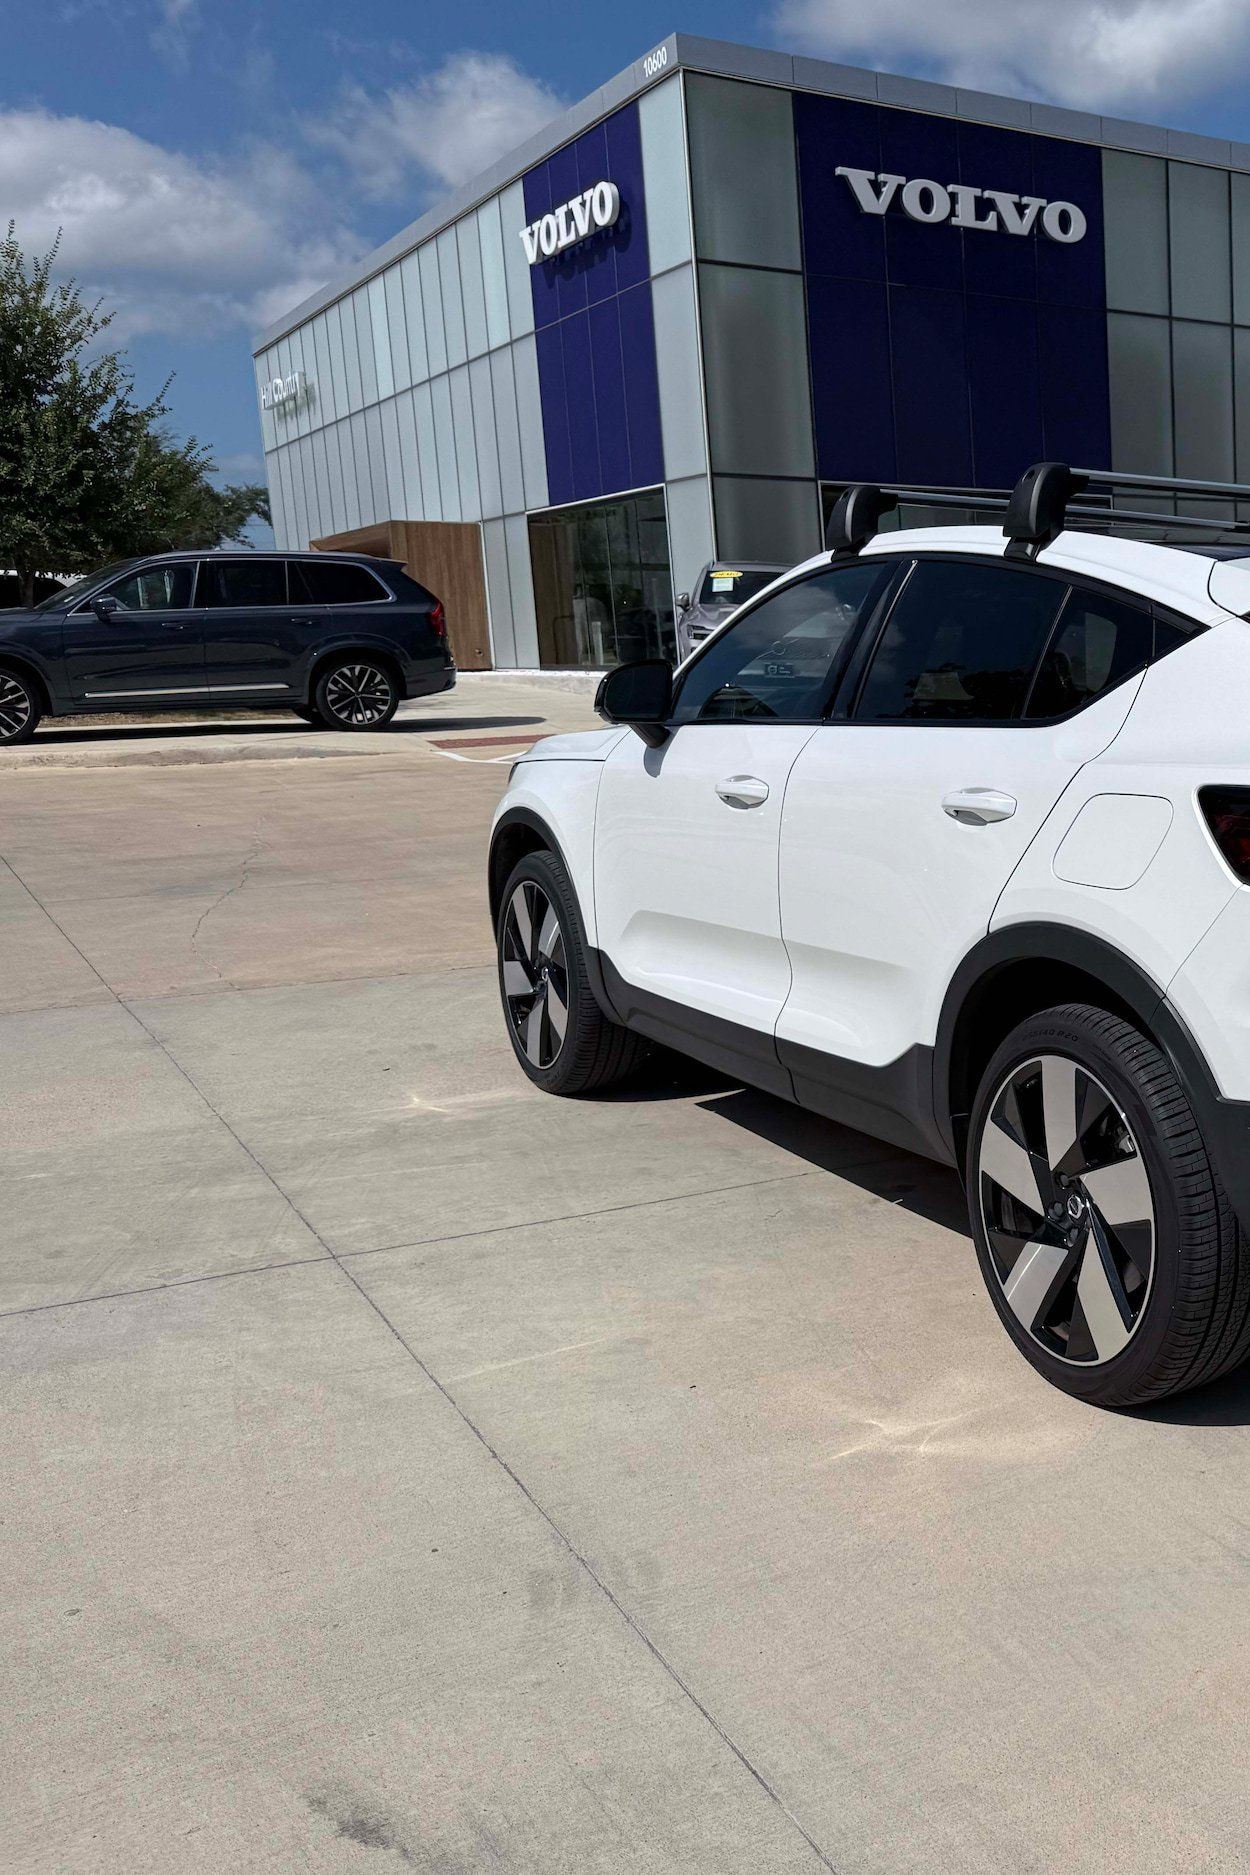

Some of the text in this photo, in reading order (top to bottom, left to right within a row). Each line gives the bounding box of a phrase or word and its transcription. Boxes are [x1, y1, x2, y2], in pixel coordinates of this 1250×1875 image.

[643, 46, 667, 78] 10600
[519, 181, 619, 265] VOLVO
[835, 166, 1087, 243] VOLVO
